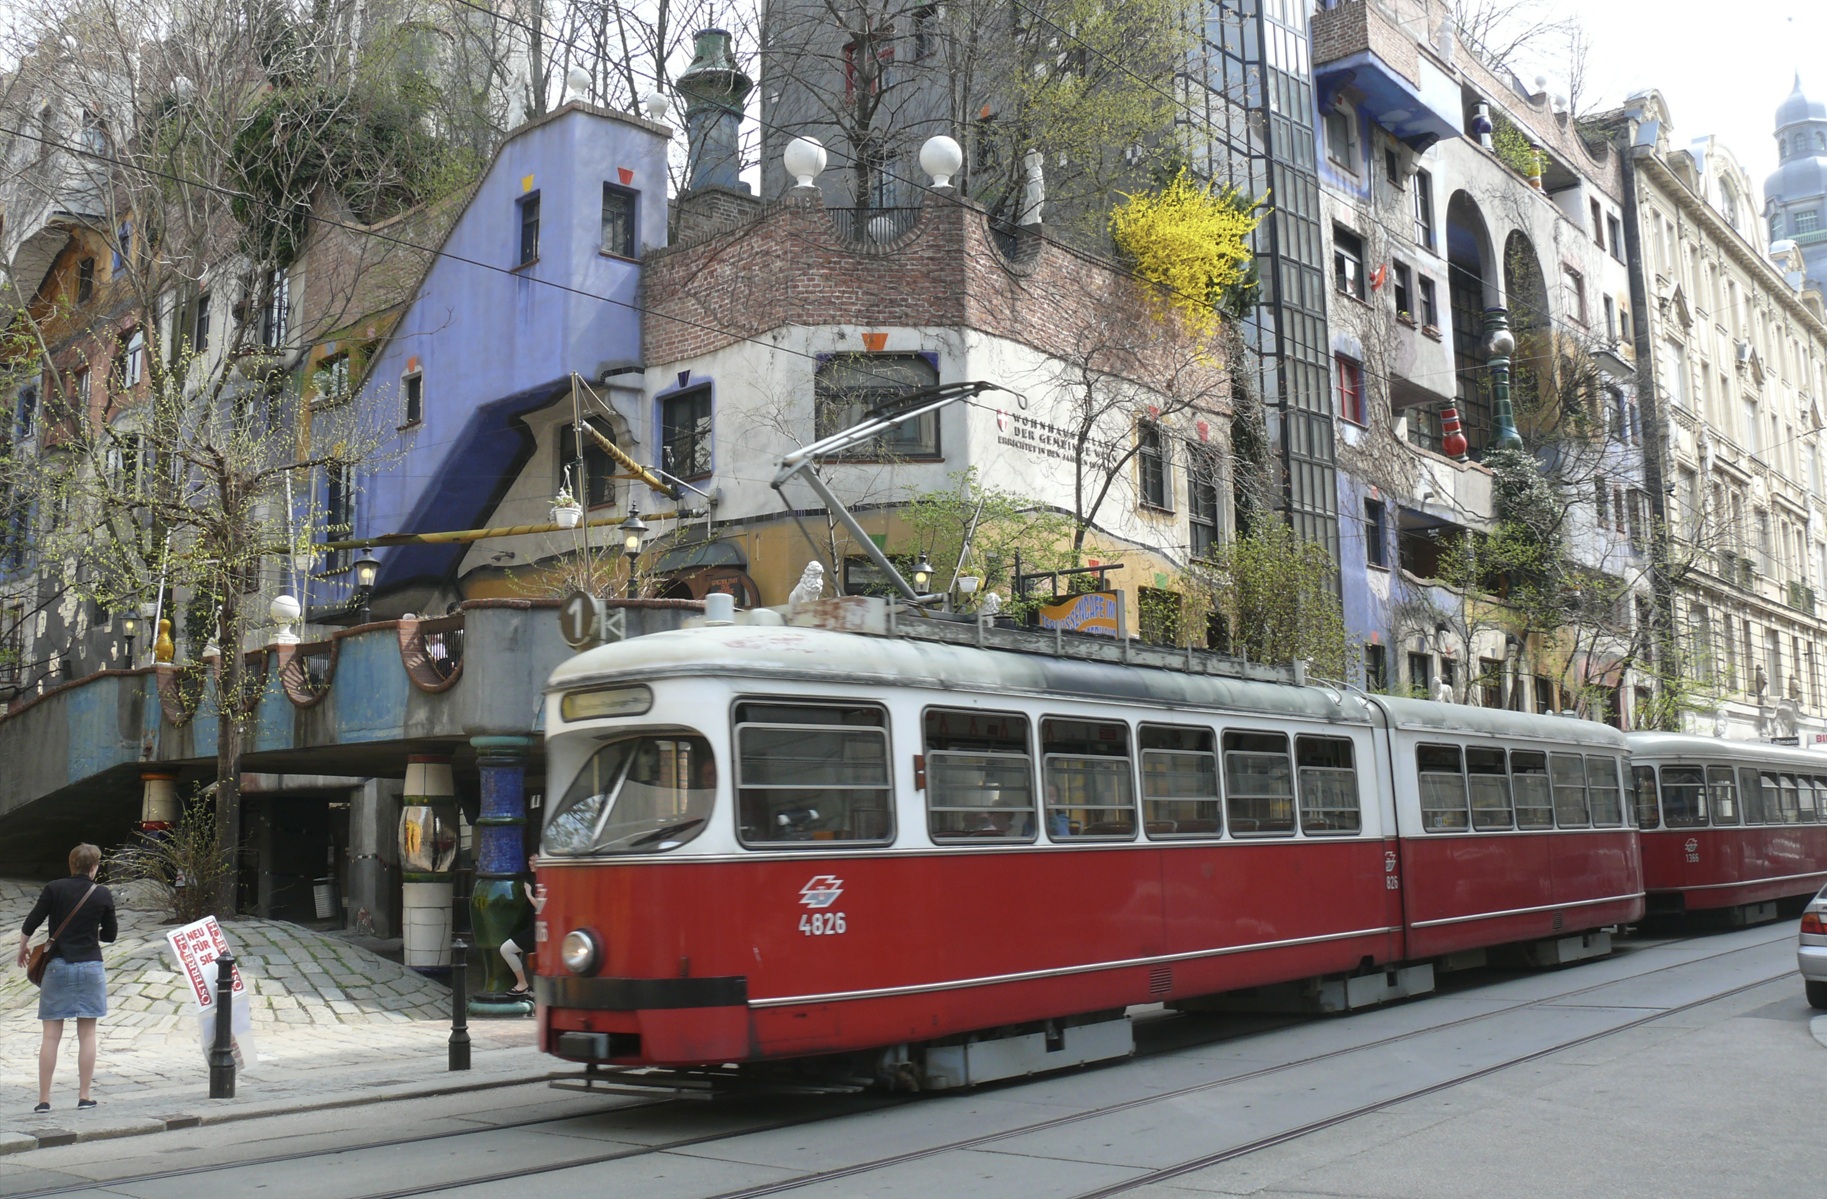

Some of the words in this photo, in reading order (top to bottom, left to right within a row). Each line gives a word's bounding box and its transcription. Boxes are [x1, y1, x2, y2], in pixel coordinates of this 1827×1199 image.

[1014, 427, 1035, 441] DER
[566, 597, 583, 639] 1
[1039, 595, 1104, 630] TERASSENCAFE
[798, 911, 847, 936] 4826
[186, 927, 205, 942] NEU
[191, 939, 211, 955] FÜR
[199, 952, 215, 967] SIE
